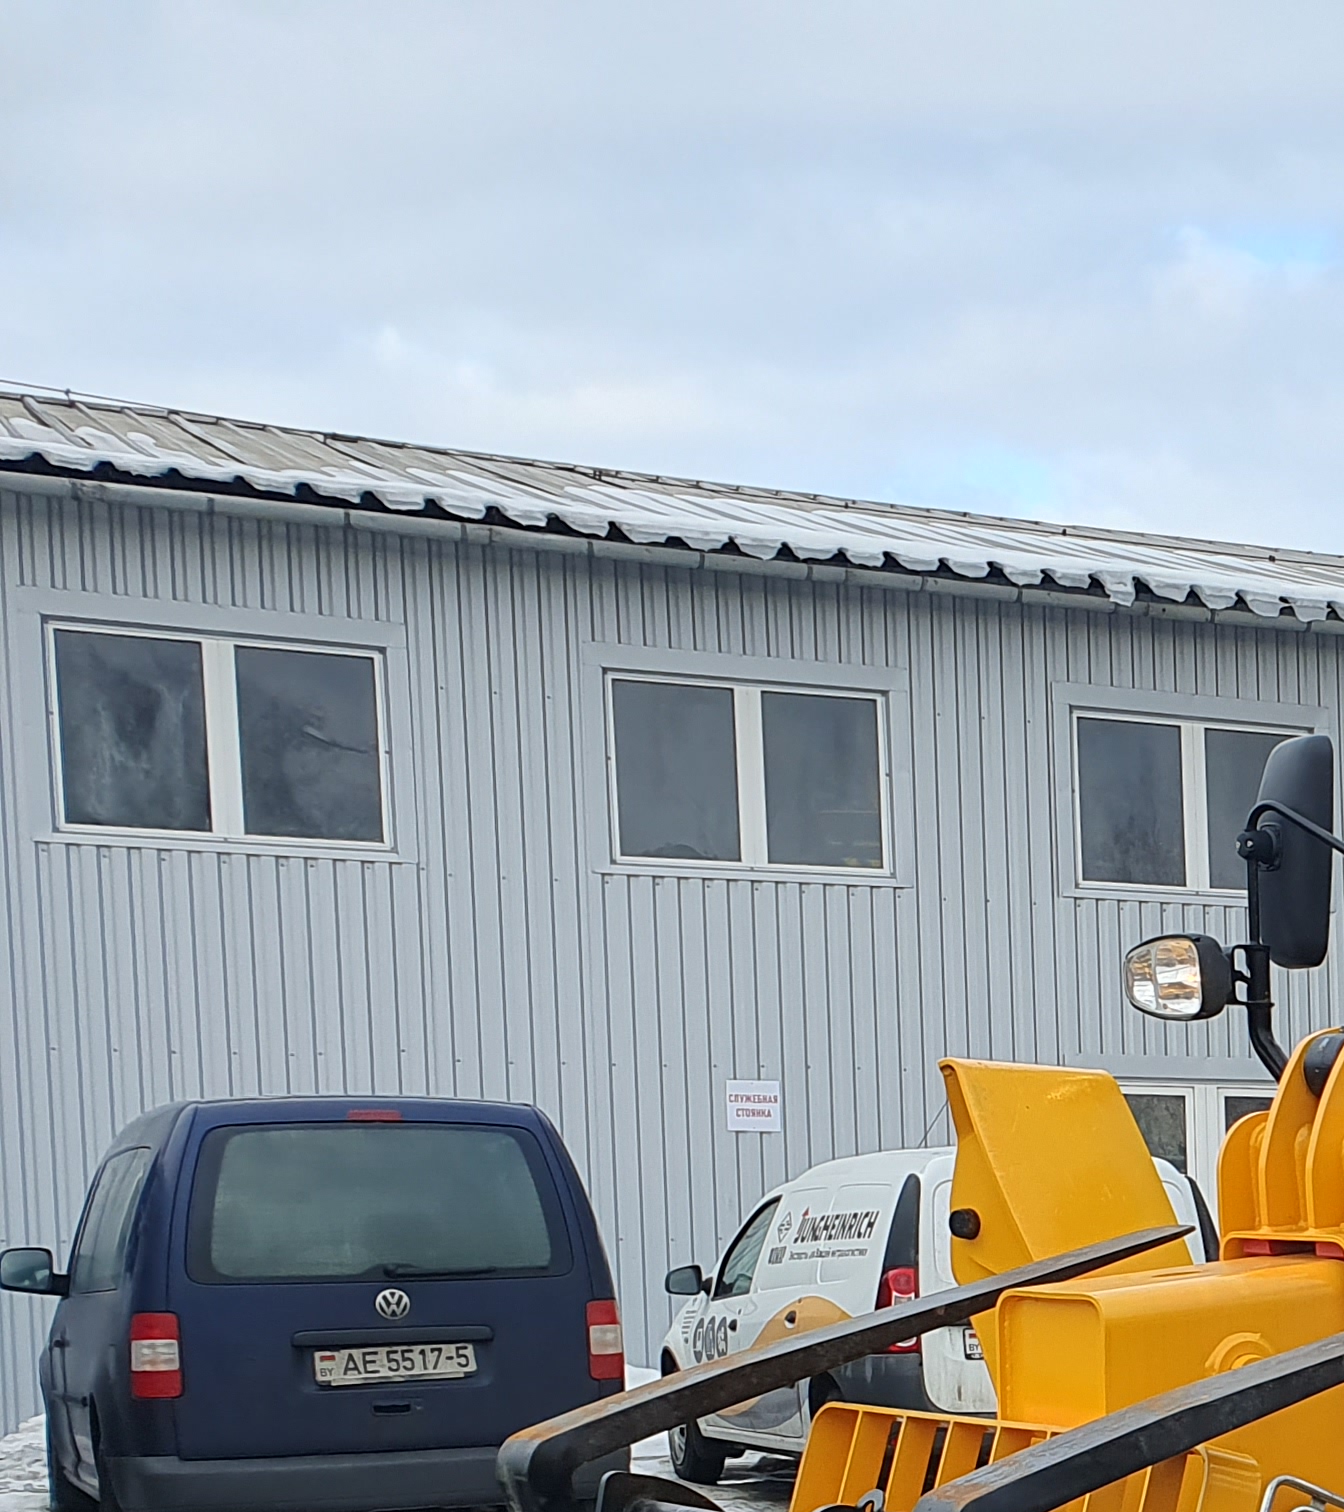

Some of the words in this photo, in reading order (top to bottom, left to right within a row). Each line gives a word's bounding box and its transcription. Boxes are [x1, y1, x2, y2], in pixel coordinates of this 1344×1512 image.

[729, 1094, 778, 1104] СЛУЖЕБНАЯ
[736, 1108, 772, 1118] СТОЯНКА
[793, 1209, 880, 1244] JUNGHEINRICH
[343, 1352, 381, 1376] AE
[386, 1345, 470, 1372] 5517-5
[320, 1368, 335, 1377] BY
